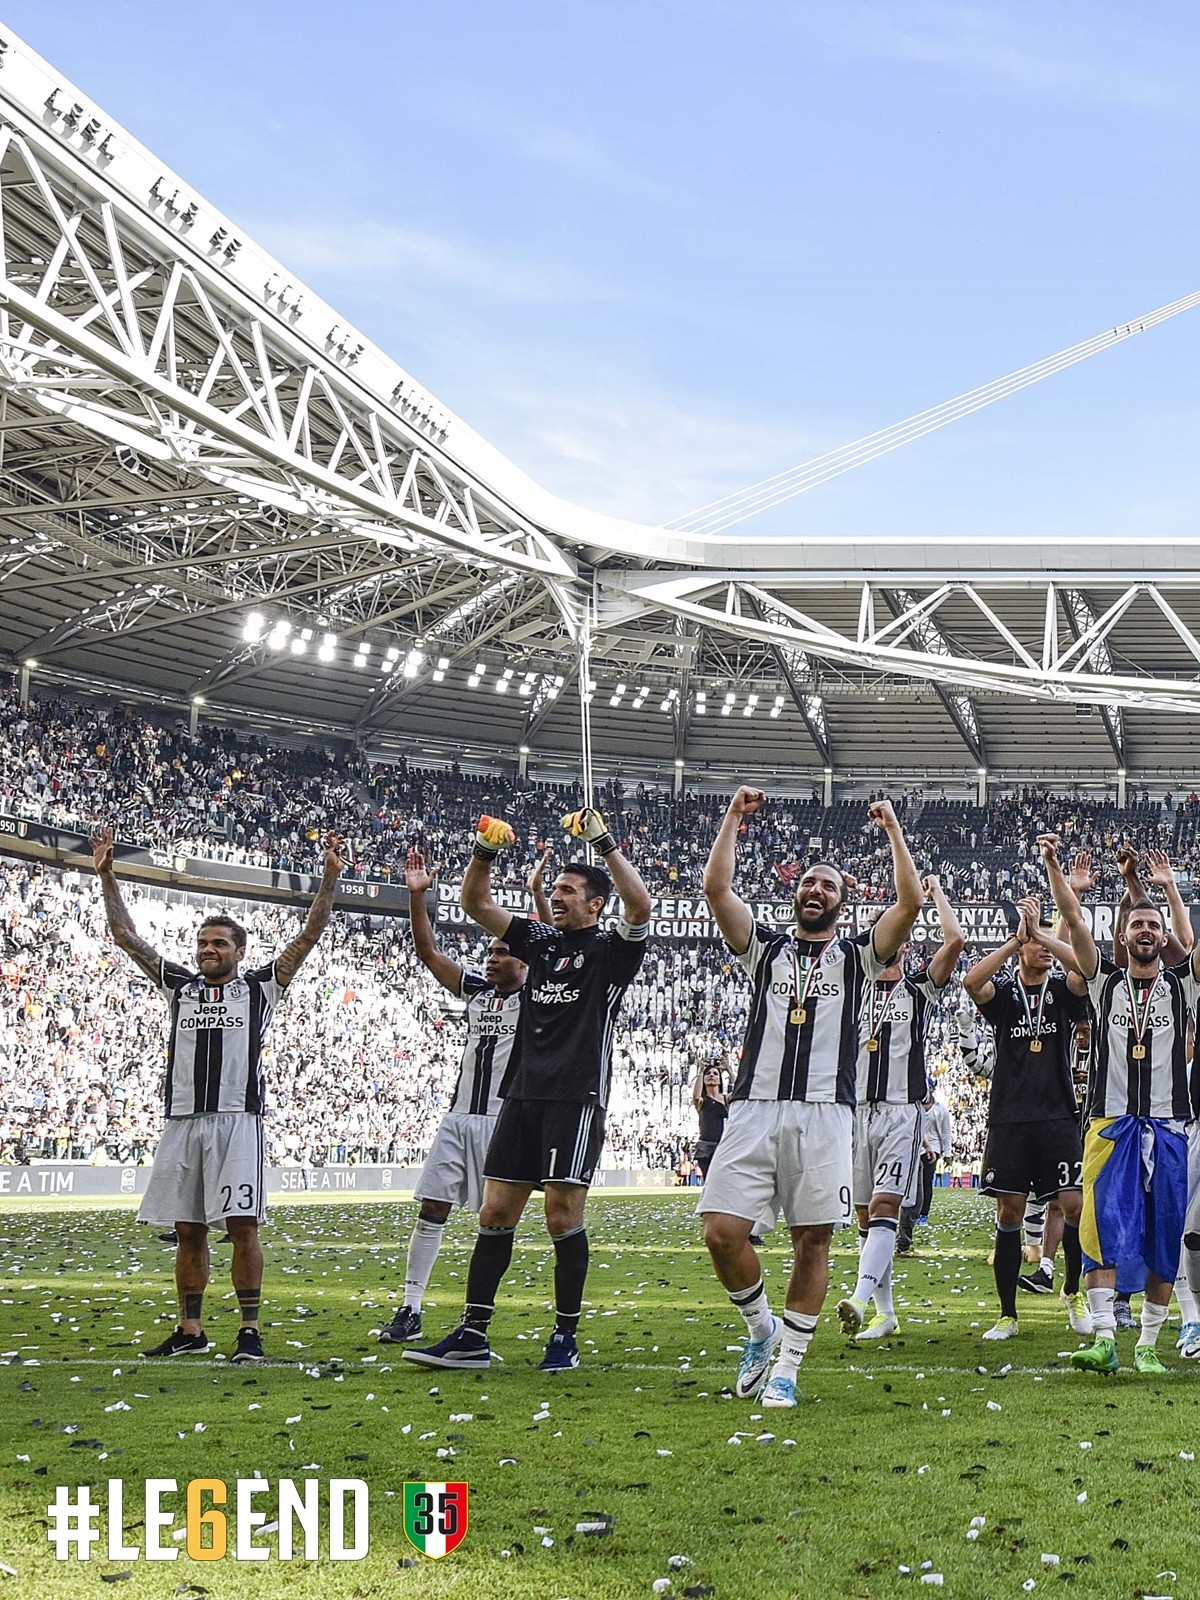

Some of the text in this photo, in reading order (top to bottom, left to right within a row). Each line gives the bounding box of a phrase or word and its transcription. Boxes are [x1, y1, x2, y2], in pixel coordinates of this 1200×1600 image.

[341, 884, 365, 895] 1958
[788, 972, 823, 984] Jep
[772, 982, 840, 997] COASS
[193, 1004, 227, 1016] Jeep
[180, 1016, 244, 1030] COMPASS
[477, 1012, 503, 1025] Jeep
[1018, 1015, 1047, 1026] Jep
[1112, 1014, 1170, 1028] COASS
[549, 1148, 558, 1178] 1
[281, 1172, 356, 1189] SERE A TIM
[875, 1161, 903, 1187] 24
[1057, 1162, 1083, 1188] 32
[16, 1171, 33, 1193] A
[38, 1171, 75, 1193] TIM
[221, 1184, 255, 1214] 23
[839, 1185, 850, 1218] 9
